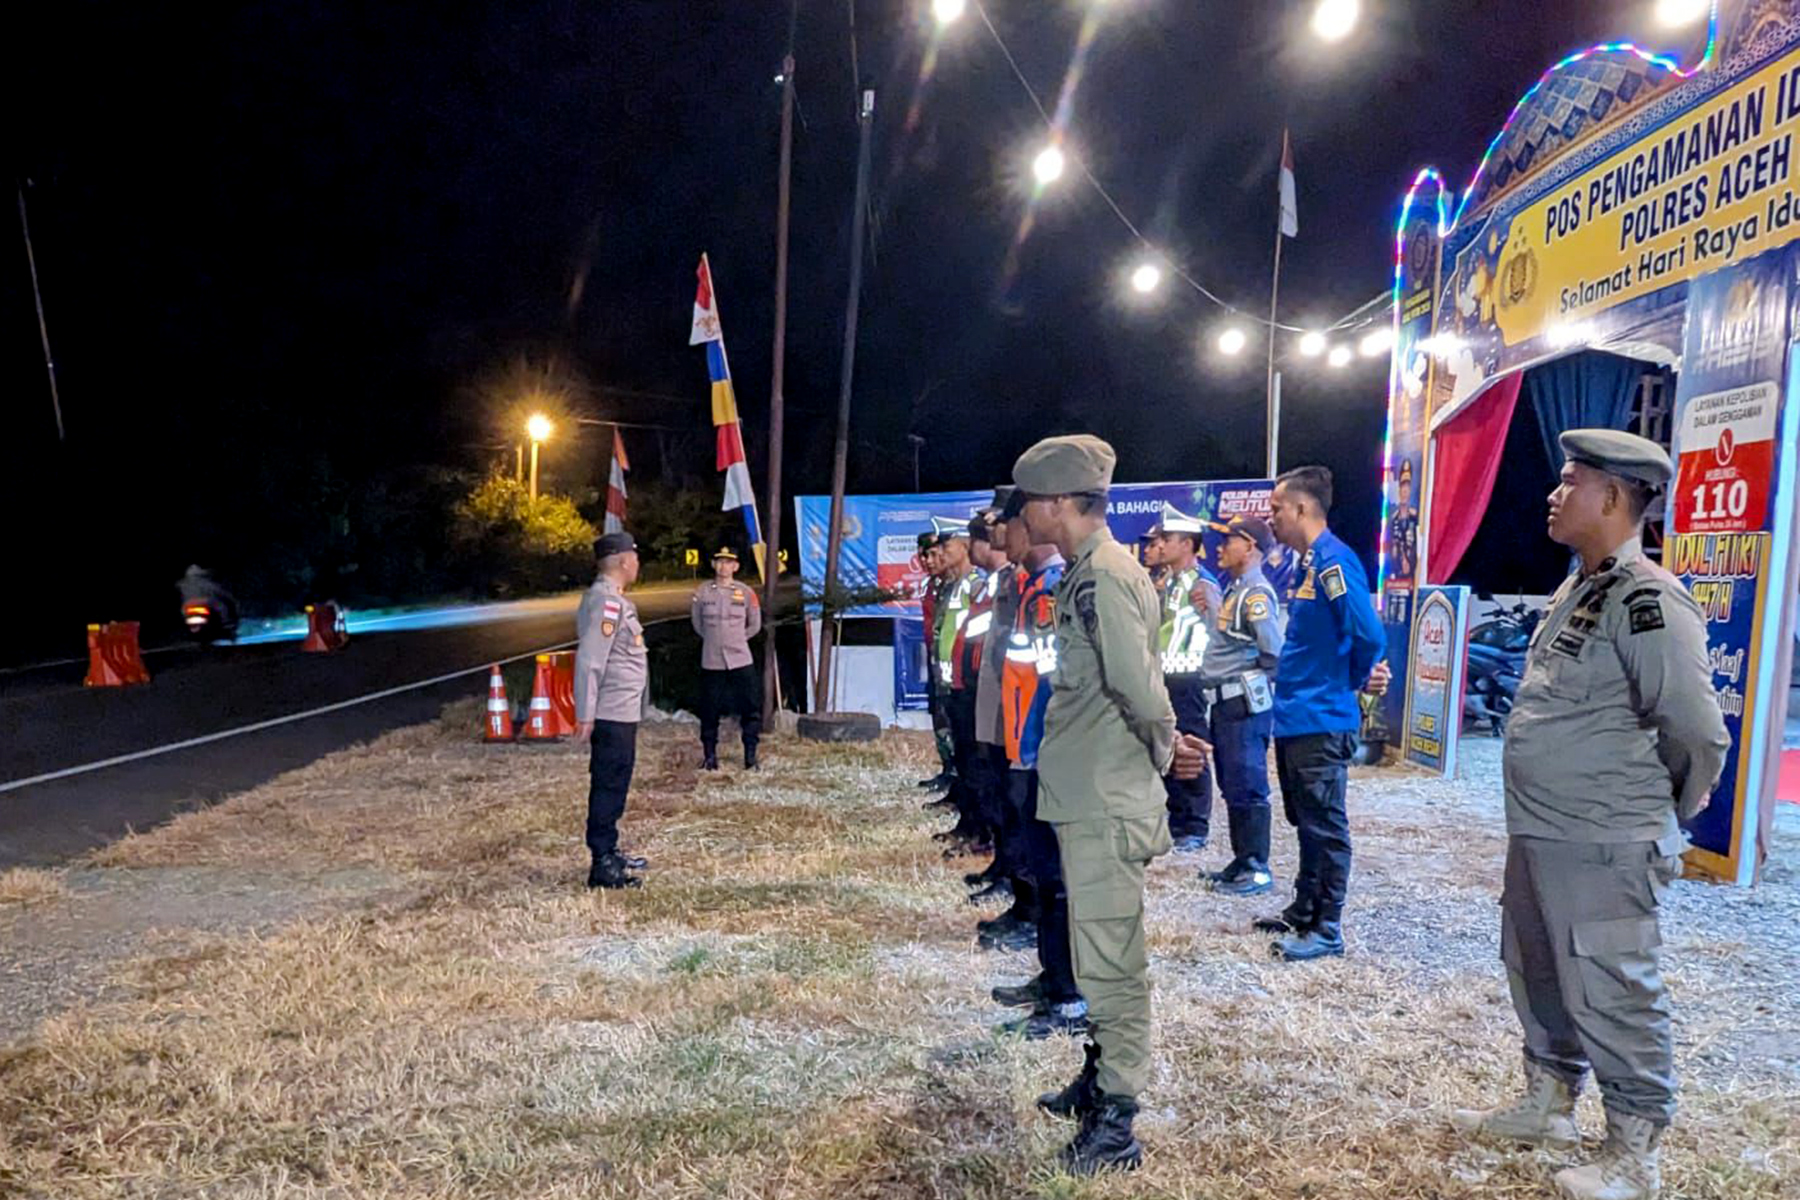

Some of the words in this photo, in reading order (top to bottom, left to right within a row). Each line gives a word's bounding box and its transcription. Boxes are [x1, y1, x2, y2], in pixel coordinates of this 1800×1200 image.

[1545, 190, 1581, 244] POS
[1587, 86, 1766, 222] PENGAMANAN
[1620, 174, 1708, 251] POLRES
[1715, 133, 1791, 209] ACEH
[1560, 264, 1631, 313] Selamat
[1638, 237, 1685, 282] Hari
[1694, 215, 1758, 262] Raya
[1218, 499, 1272, 513] MEUTU
[1691, 479, 1748, 519] 110
[1674, 534, 1710, 576] IDUL
[1717, 687, 1742, 716] thin
